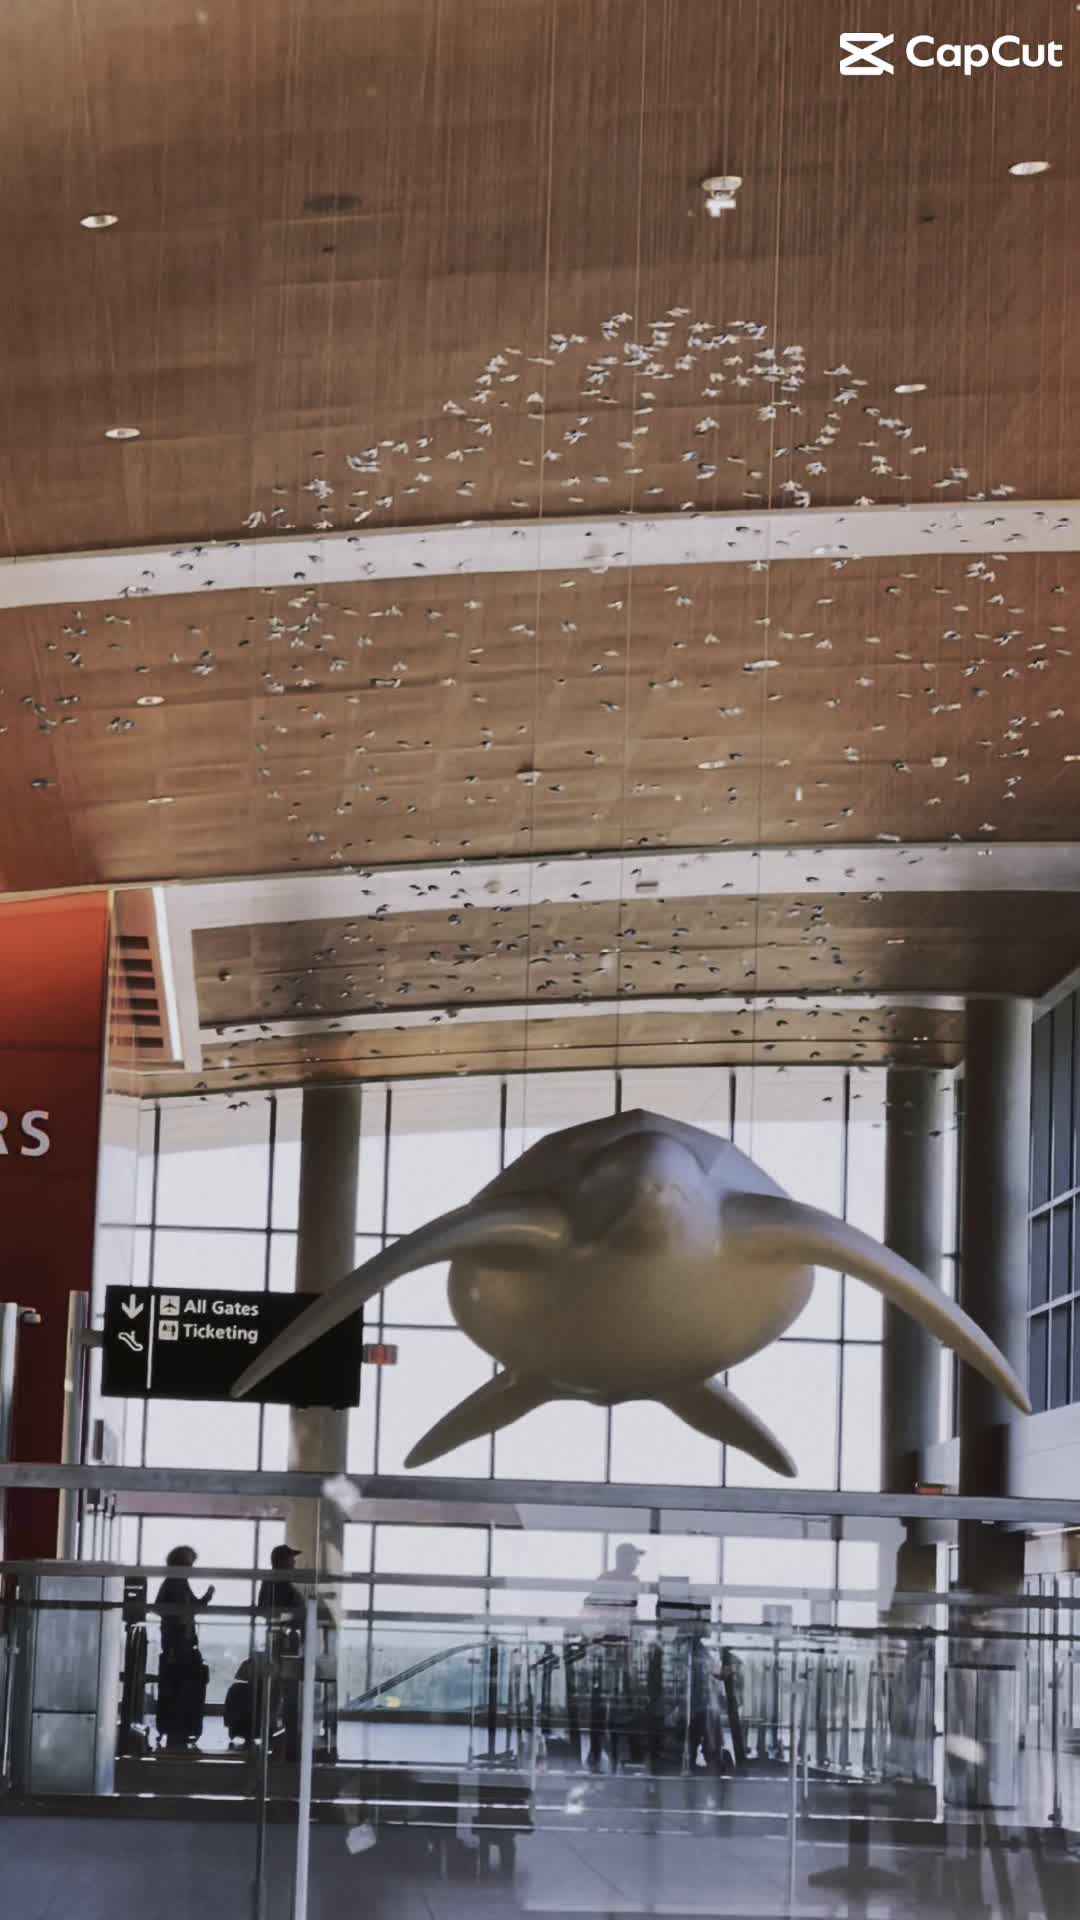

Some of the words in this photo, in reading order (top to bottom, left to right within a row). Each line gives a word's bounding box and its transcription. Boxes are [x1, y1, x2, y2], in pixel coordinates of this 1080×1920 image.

[183, 1299, 207, 1314] All
[211, 1300, 259, 1317] Gates
[183, 1323, 259, 1344] Ticketing
